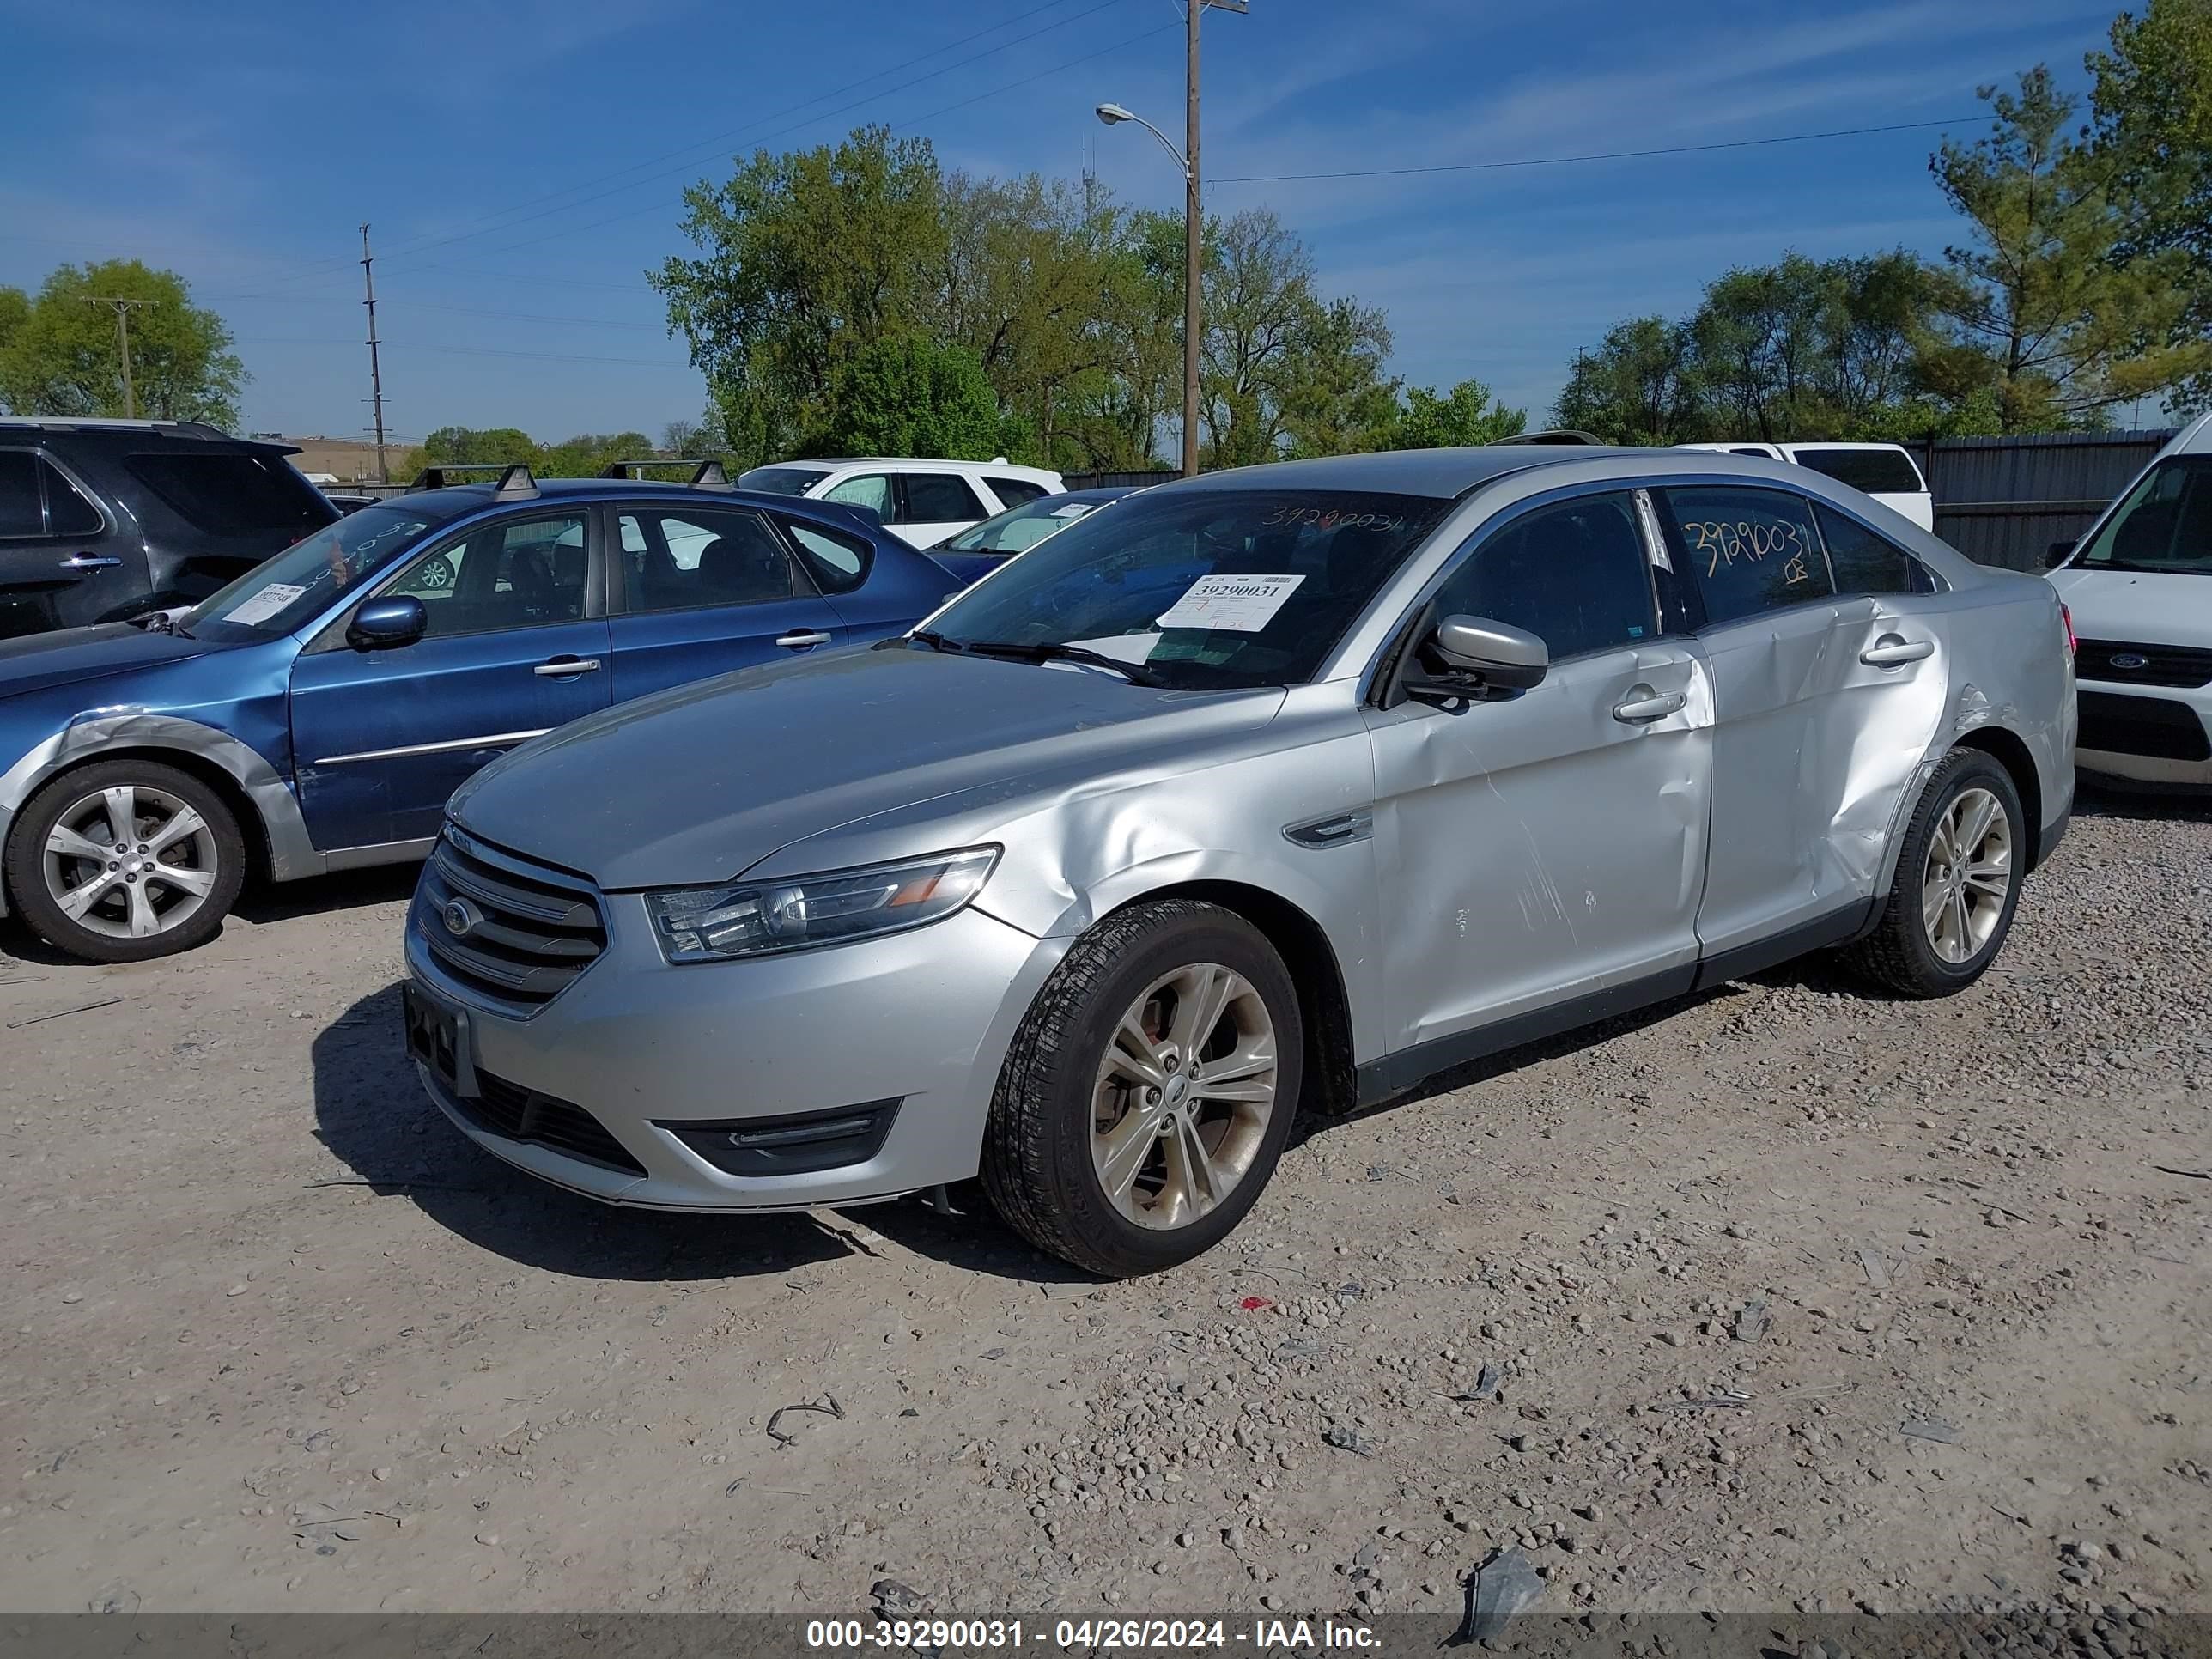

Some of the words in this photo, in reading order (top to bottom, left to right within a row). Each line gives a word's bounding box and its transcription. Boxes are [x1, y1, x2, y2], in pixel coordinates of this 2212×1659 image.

[1261, 506, 1404, 532] 39290031
[1684, 519, 1812, 578] 39290031
[1194, 585, 1280, 598] 39290031
